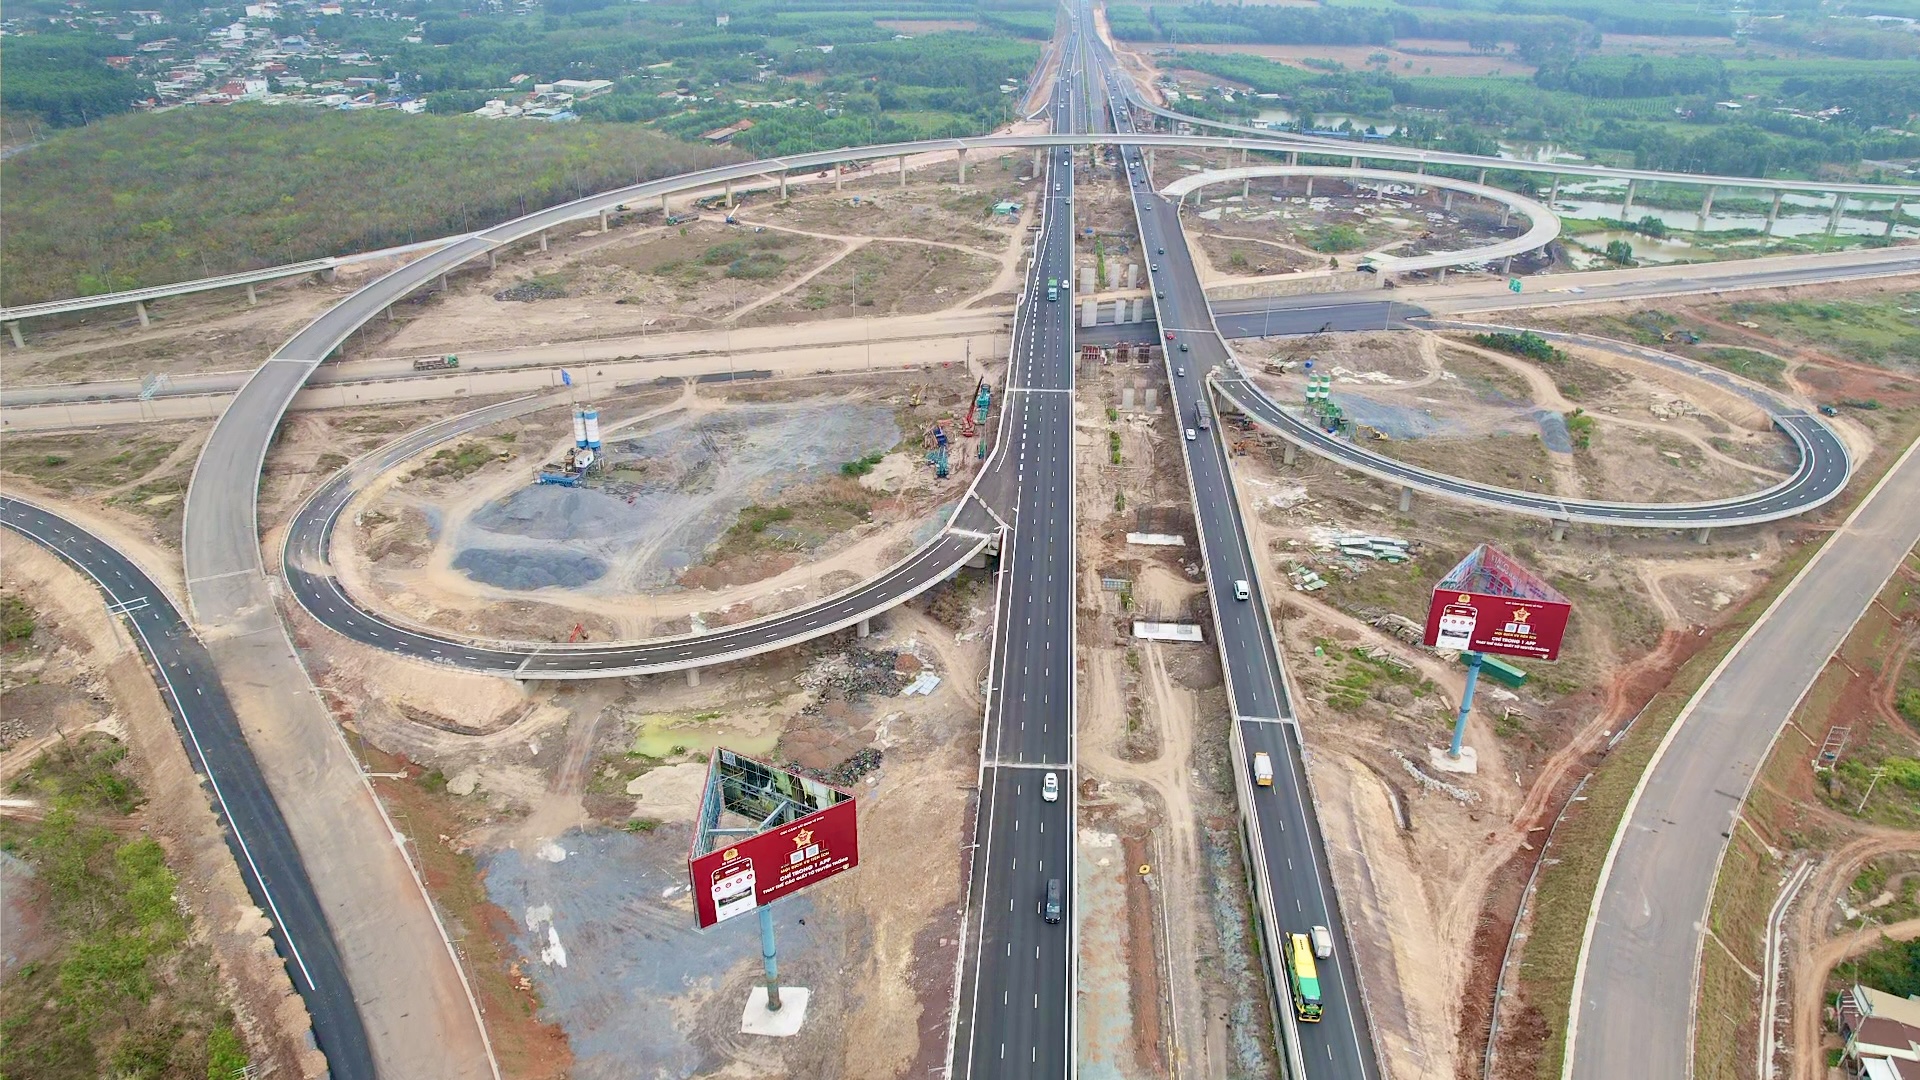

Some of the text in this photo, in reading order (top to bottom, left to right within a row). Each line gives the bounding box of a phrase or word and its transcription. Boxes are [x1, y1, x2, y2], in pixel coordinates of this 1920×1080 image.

[779, 872, 792, 882] CHỈ
[792, 865, 813, 876] TRONG
[820, 857, 831, 865] APP
